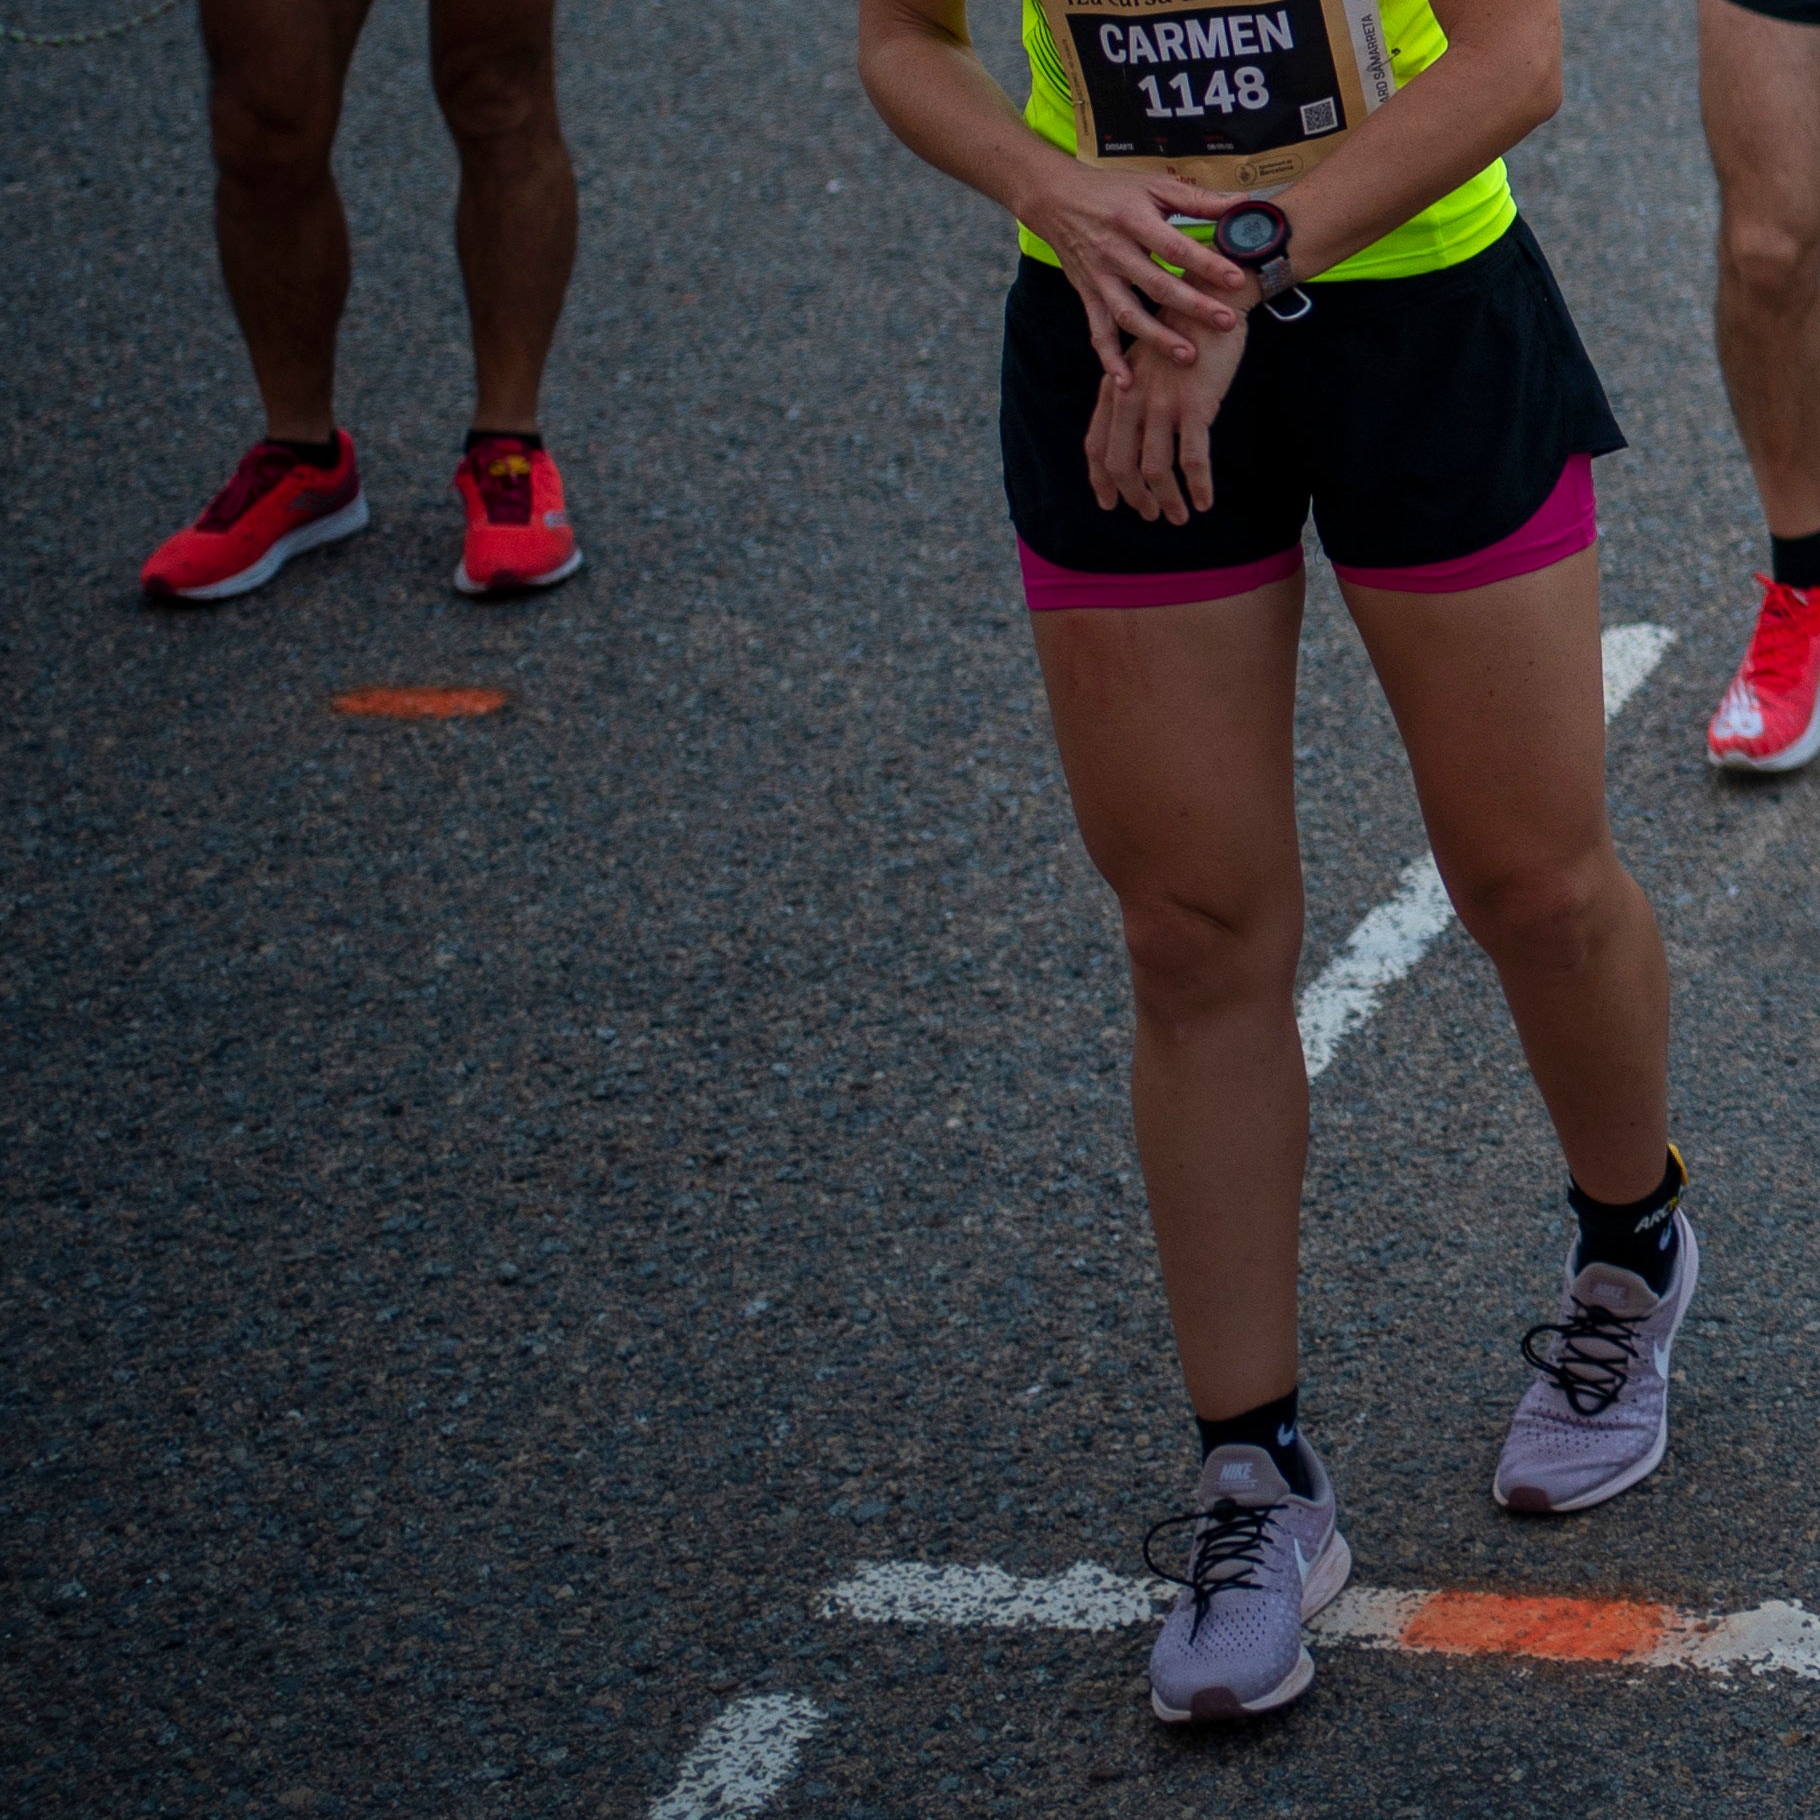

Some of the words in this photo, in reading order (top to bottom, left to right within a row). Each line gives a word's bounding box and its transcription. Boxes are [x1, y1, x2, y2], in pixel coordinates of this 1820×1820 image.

[1099, 10, 1294, 64] CARMEN
[1361, 13, 1386, 81] SAMARRETA
[1138, 66, 1270, 118] 1148
